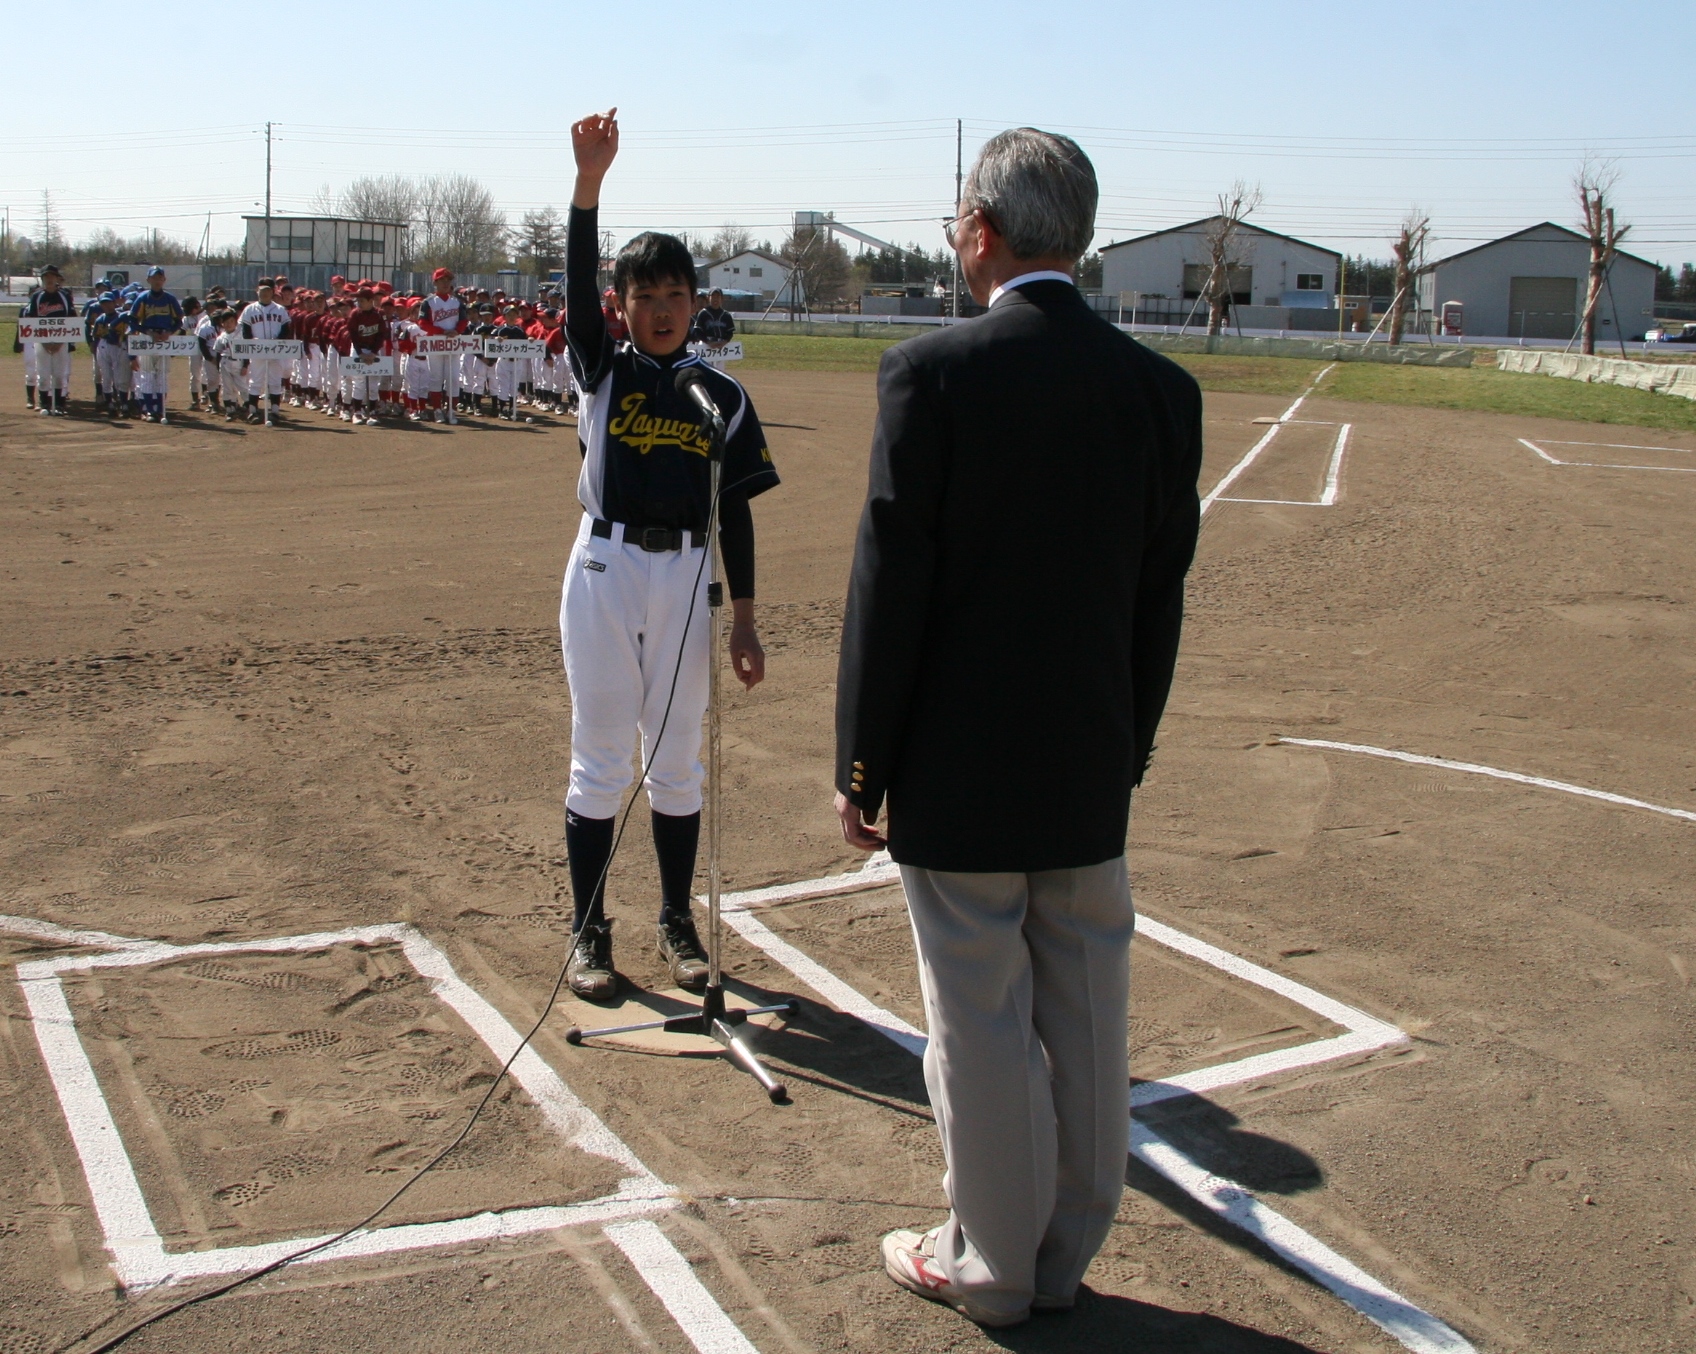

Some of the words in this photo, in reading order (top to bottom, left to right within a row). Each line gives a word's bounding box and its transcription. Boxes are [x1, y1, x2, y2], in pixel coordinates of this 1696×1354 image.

[697, 345, 741, 358] ムファイターズ
